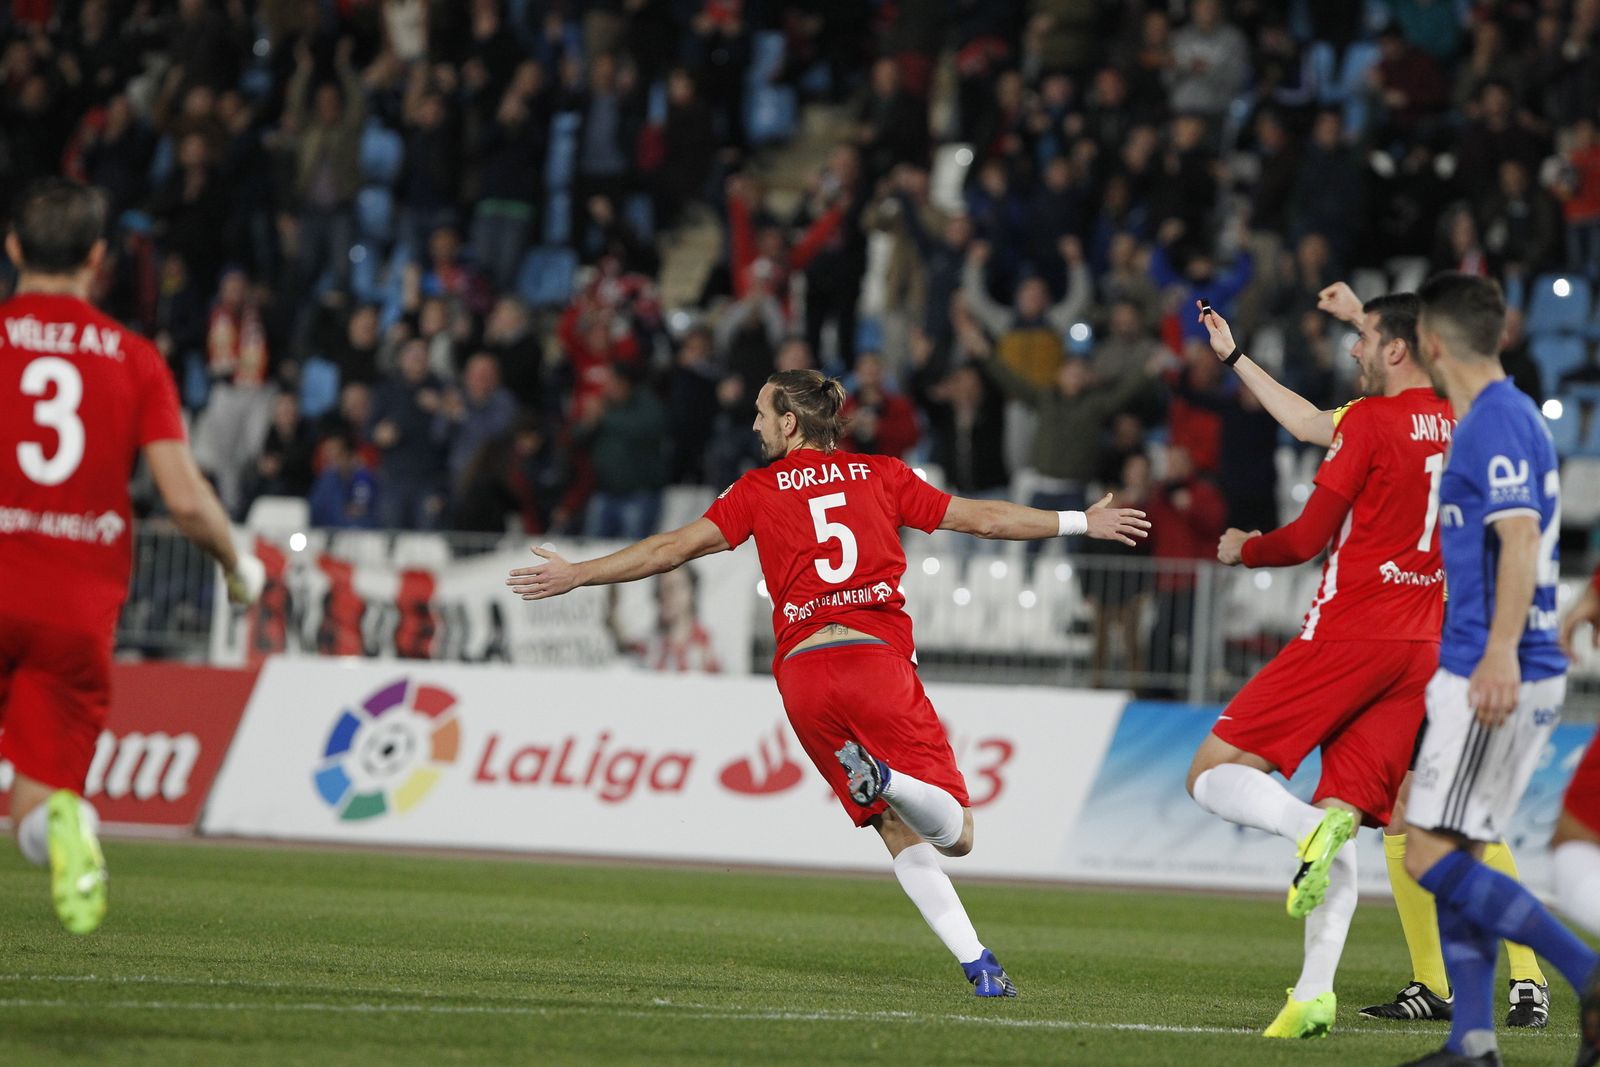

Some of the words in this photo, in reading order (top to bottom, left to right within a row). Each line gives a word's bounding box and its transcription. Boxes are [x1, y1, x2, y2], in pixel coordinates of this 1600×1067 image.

[17, 356, 85, 486] 3
[1409, 413, 1439, 442] JAVI
[776, 463, 845, 490] BORJA
[848, 462, 871, 481] FF
[808, 492, 858, 584] 5
[832, 584, 873, 607] ALMERÍA
[473, 729, 694, 805] LaLiga
